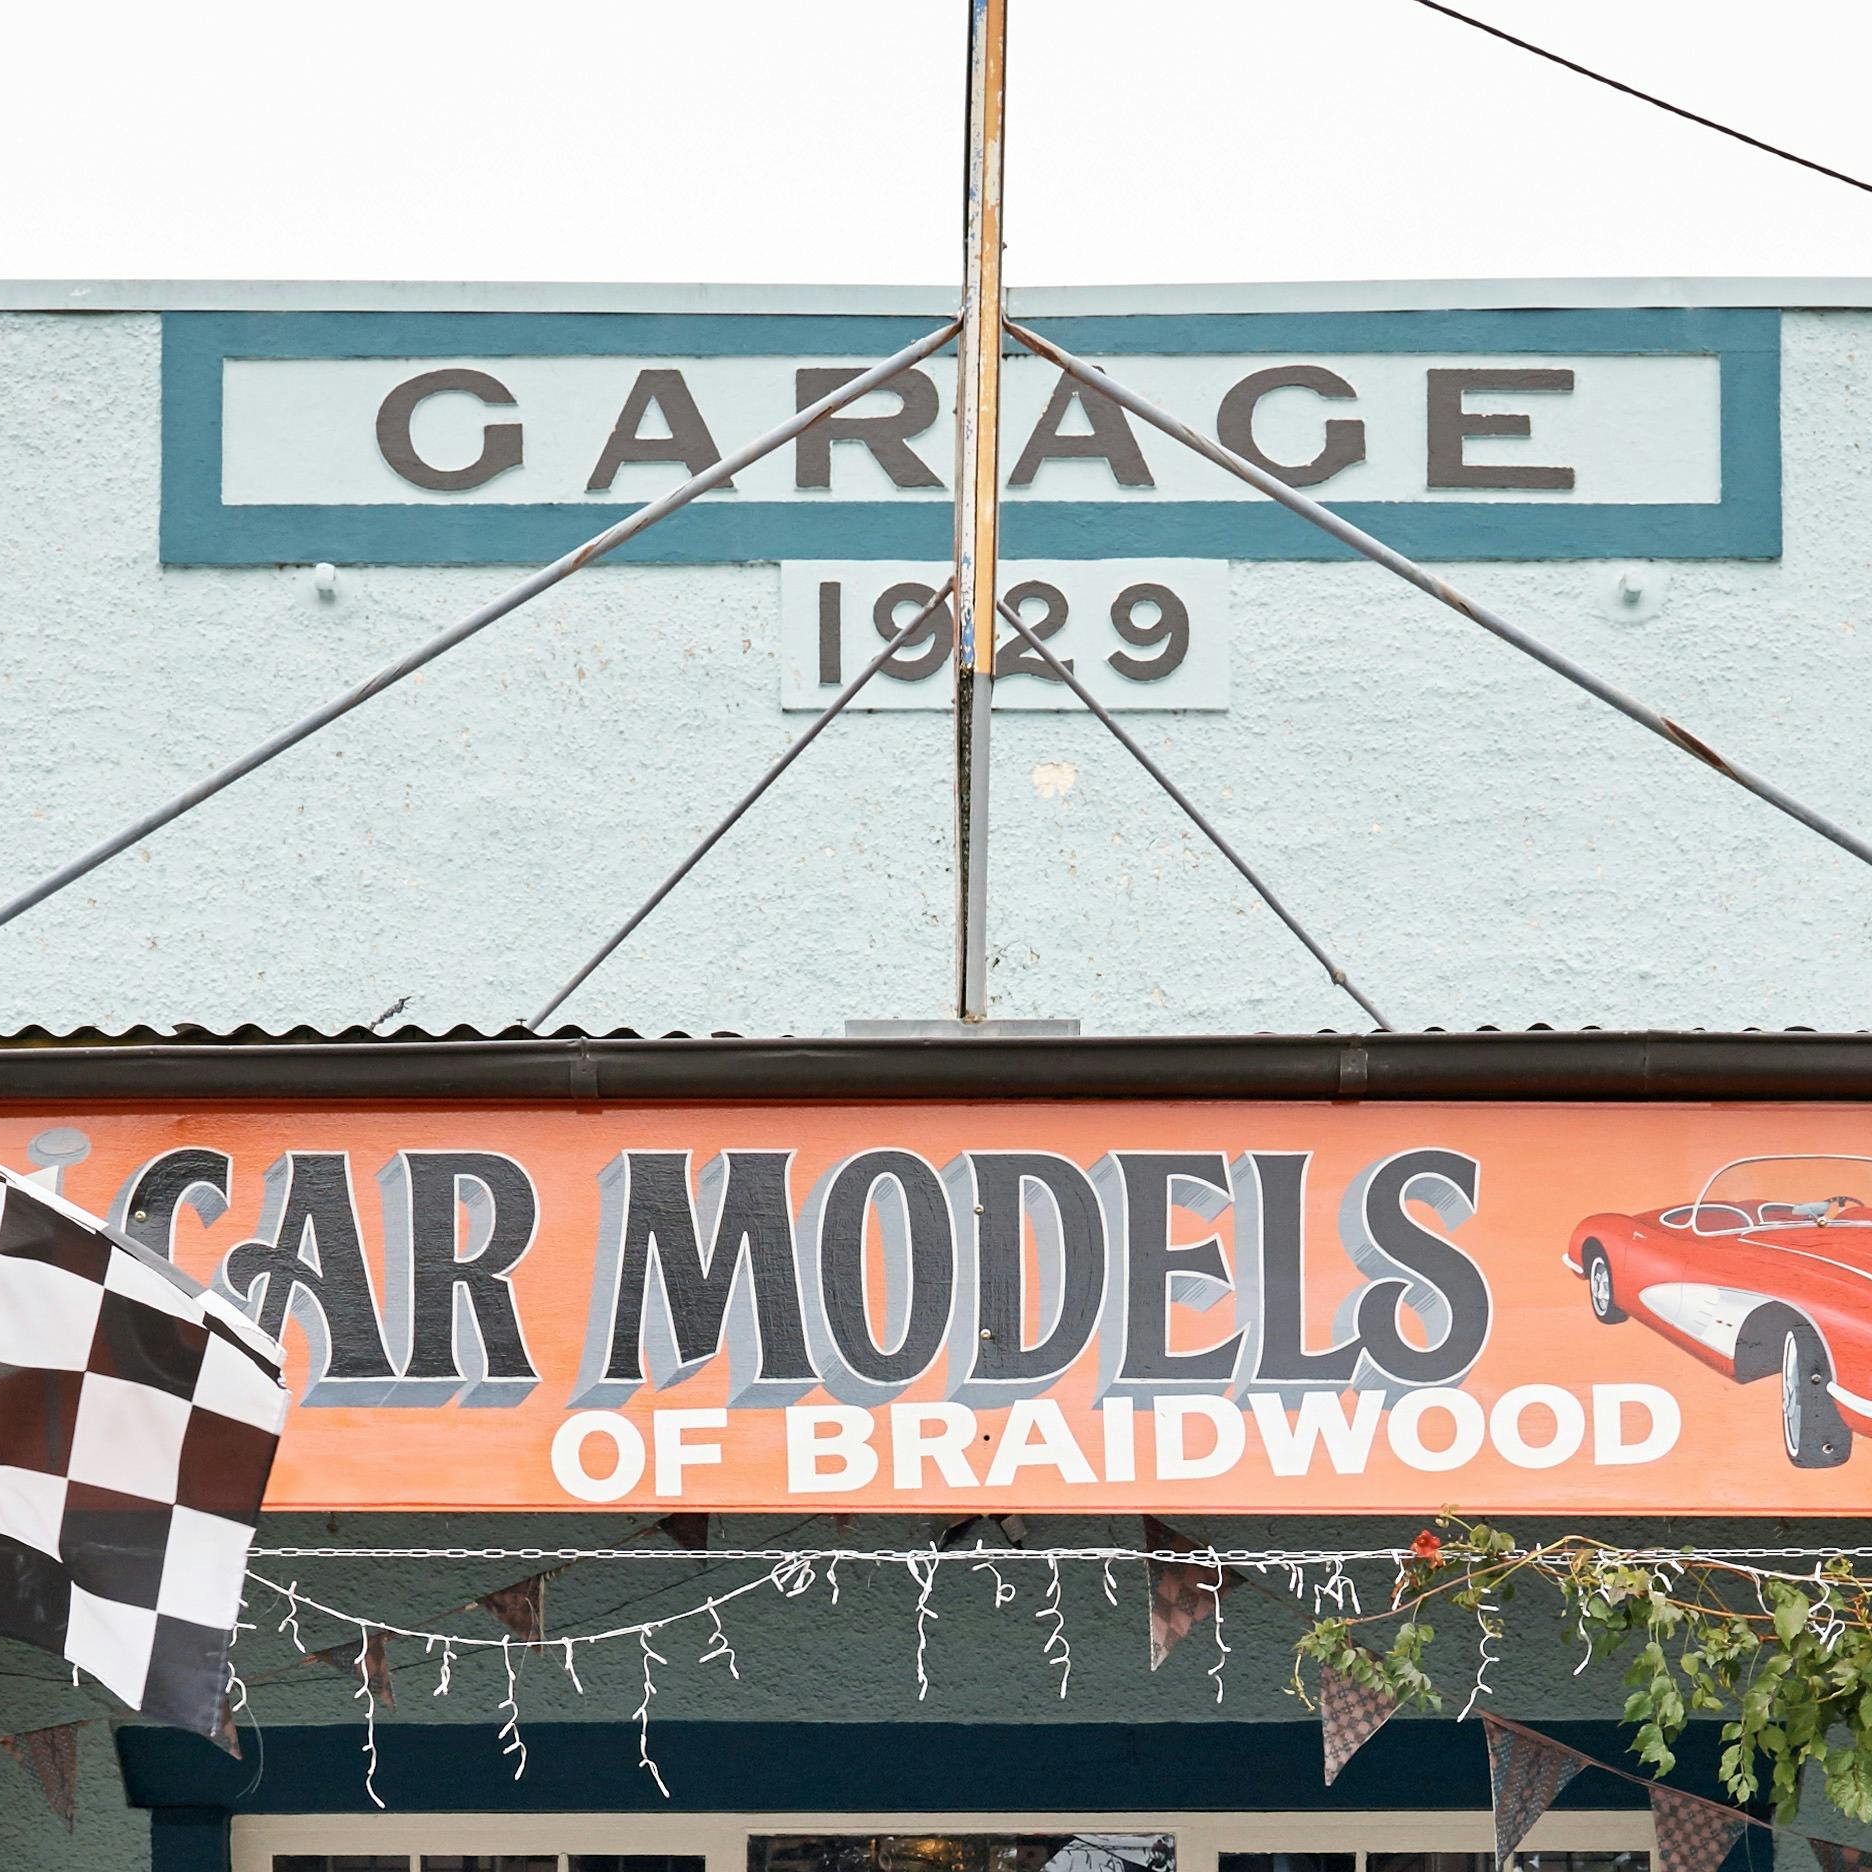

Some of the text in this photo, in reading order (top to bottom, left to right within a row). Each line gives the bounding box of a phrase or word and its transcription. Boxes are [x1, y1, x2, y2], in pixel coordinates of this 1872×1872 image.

[376, 365, 1578, 493] GARAGE
[816, 578, 1191, 685] 1929
[568, 1145, 1493, 1412] MODELS
[552, 1382, 1683, 1502] OF BRAIDWOOD
